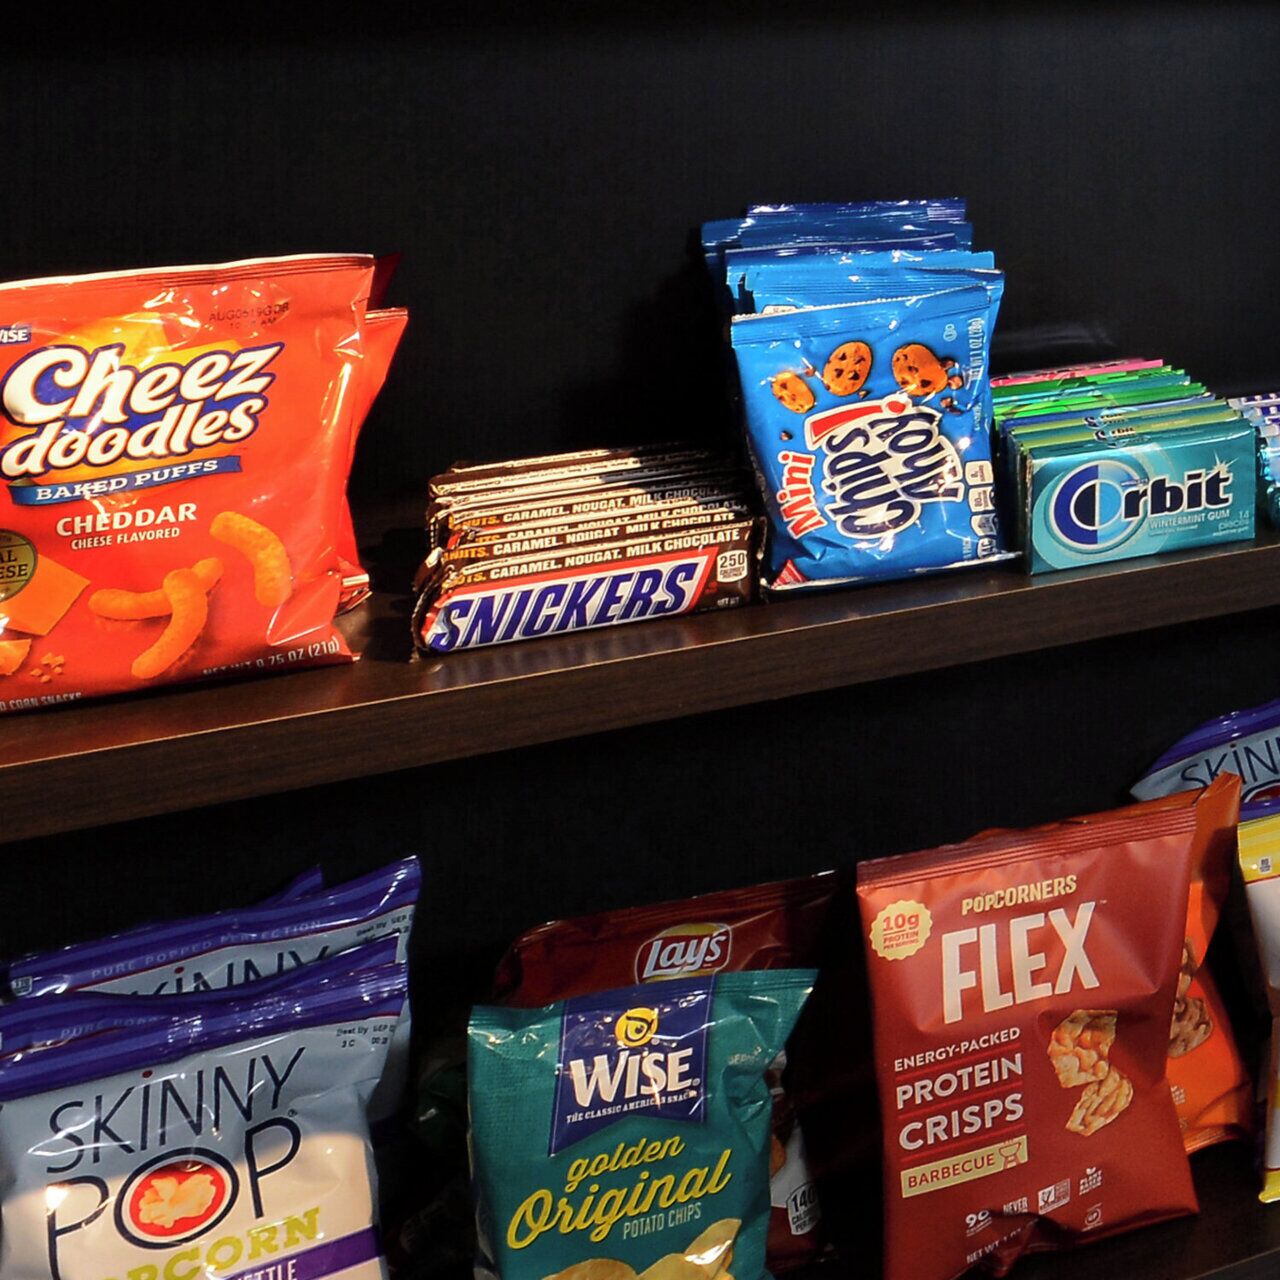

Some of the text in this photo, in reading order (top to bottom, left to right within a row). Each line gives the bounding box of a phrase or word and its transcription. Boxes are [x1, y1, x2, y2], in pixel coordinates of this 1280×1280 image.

[3, 344, 284, 420] Cheez
[1, 397, 266, 476] doodles
[36, 458, 219, 502] BAKED PUFFS
[777, 451, 827, 538] Mini
[823, 426, 916, 536] Chips
[1053, 460, 1234, 546] Orbit
[56, 502, 197, 538] CHEDDAR
[71, 527, 181, 550] CHEESE FLAVORED
[664, 529, 740, 552] CHOCOLATE
[1207, 509, 1231, 521] GUM
[719, 552, 747, 568] 250
[426, 563, 699, 653] SNICKERS
[882, 910, 920, 933] 10g
[961, 874, 1077, 916] POPCORNERS
[643, 932, 731, 976] Lay's
[941, 902, 1100, 1024] FLEX
[894, 1027, 1021, 1072] ENERGY-PACKED
[568, 1047, 694, 1108] WISE
[895, 1053, 1023, 1110] PROTEIN
[46, 1047, 305, 1174] SKINNY
[898, 1093, 1024, 1151] CRISPS
[567, 1135, 685, 1190] golden
[907, 1152, 996, 1189] BARBECUE
[506, 1149, 733, 1251] Original
[623, 1202, 702, 1240] POTATO CHIPS
